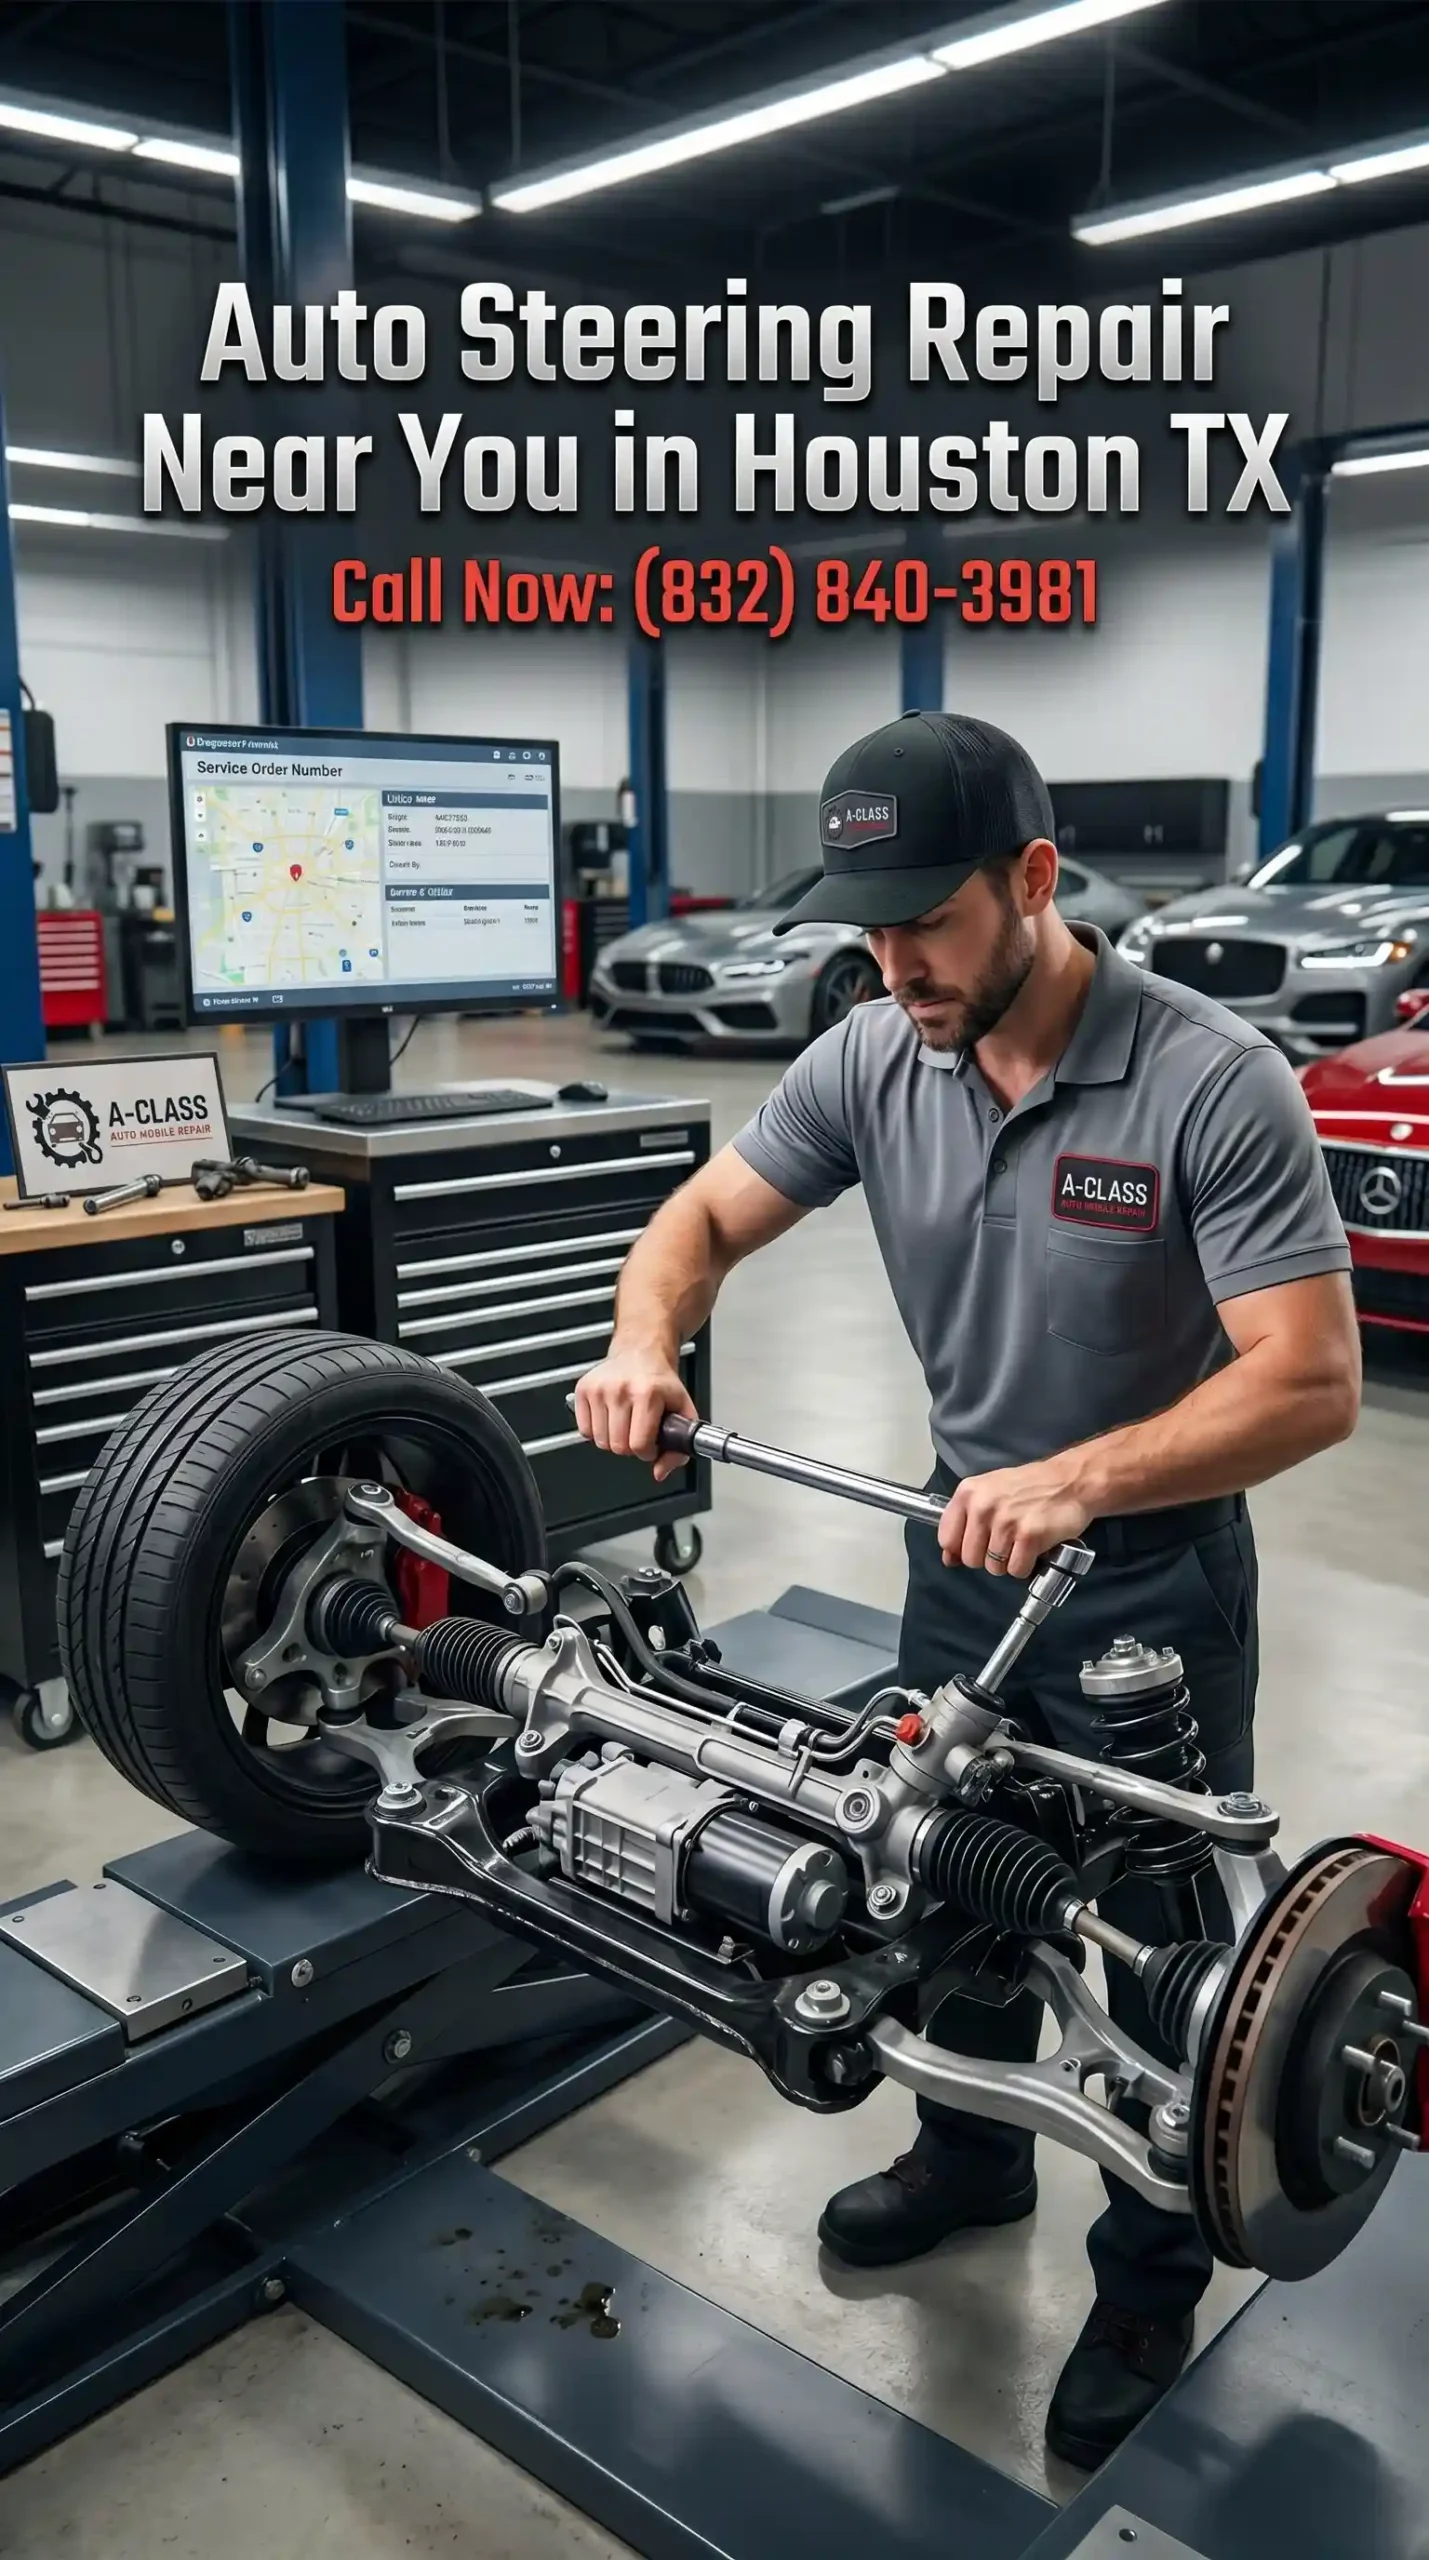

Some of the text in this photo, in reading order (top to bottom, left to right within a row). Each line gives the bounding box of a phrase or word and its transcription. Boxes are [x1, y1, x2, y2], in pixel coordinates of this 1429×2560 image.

[197, 760, 343, 778] Service Order Number
[846, 806, 889, 822] A-CLASS
[109, 1094, 209, 1128] A-CLASS
[110, 1124, 212, 1141] AUTO MOBILE REPAIR
[1061, 1173, 1148, 1206] A-CLASS
